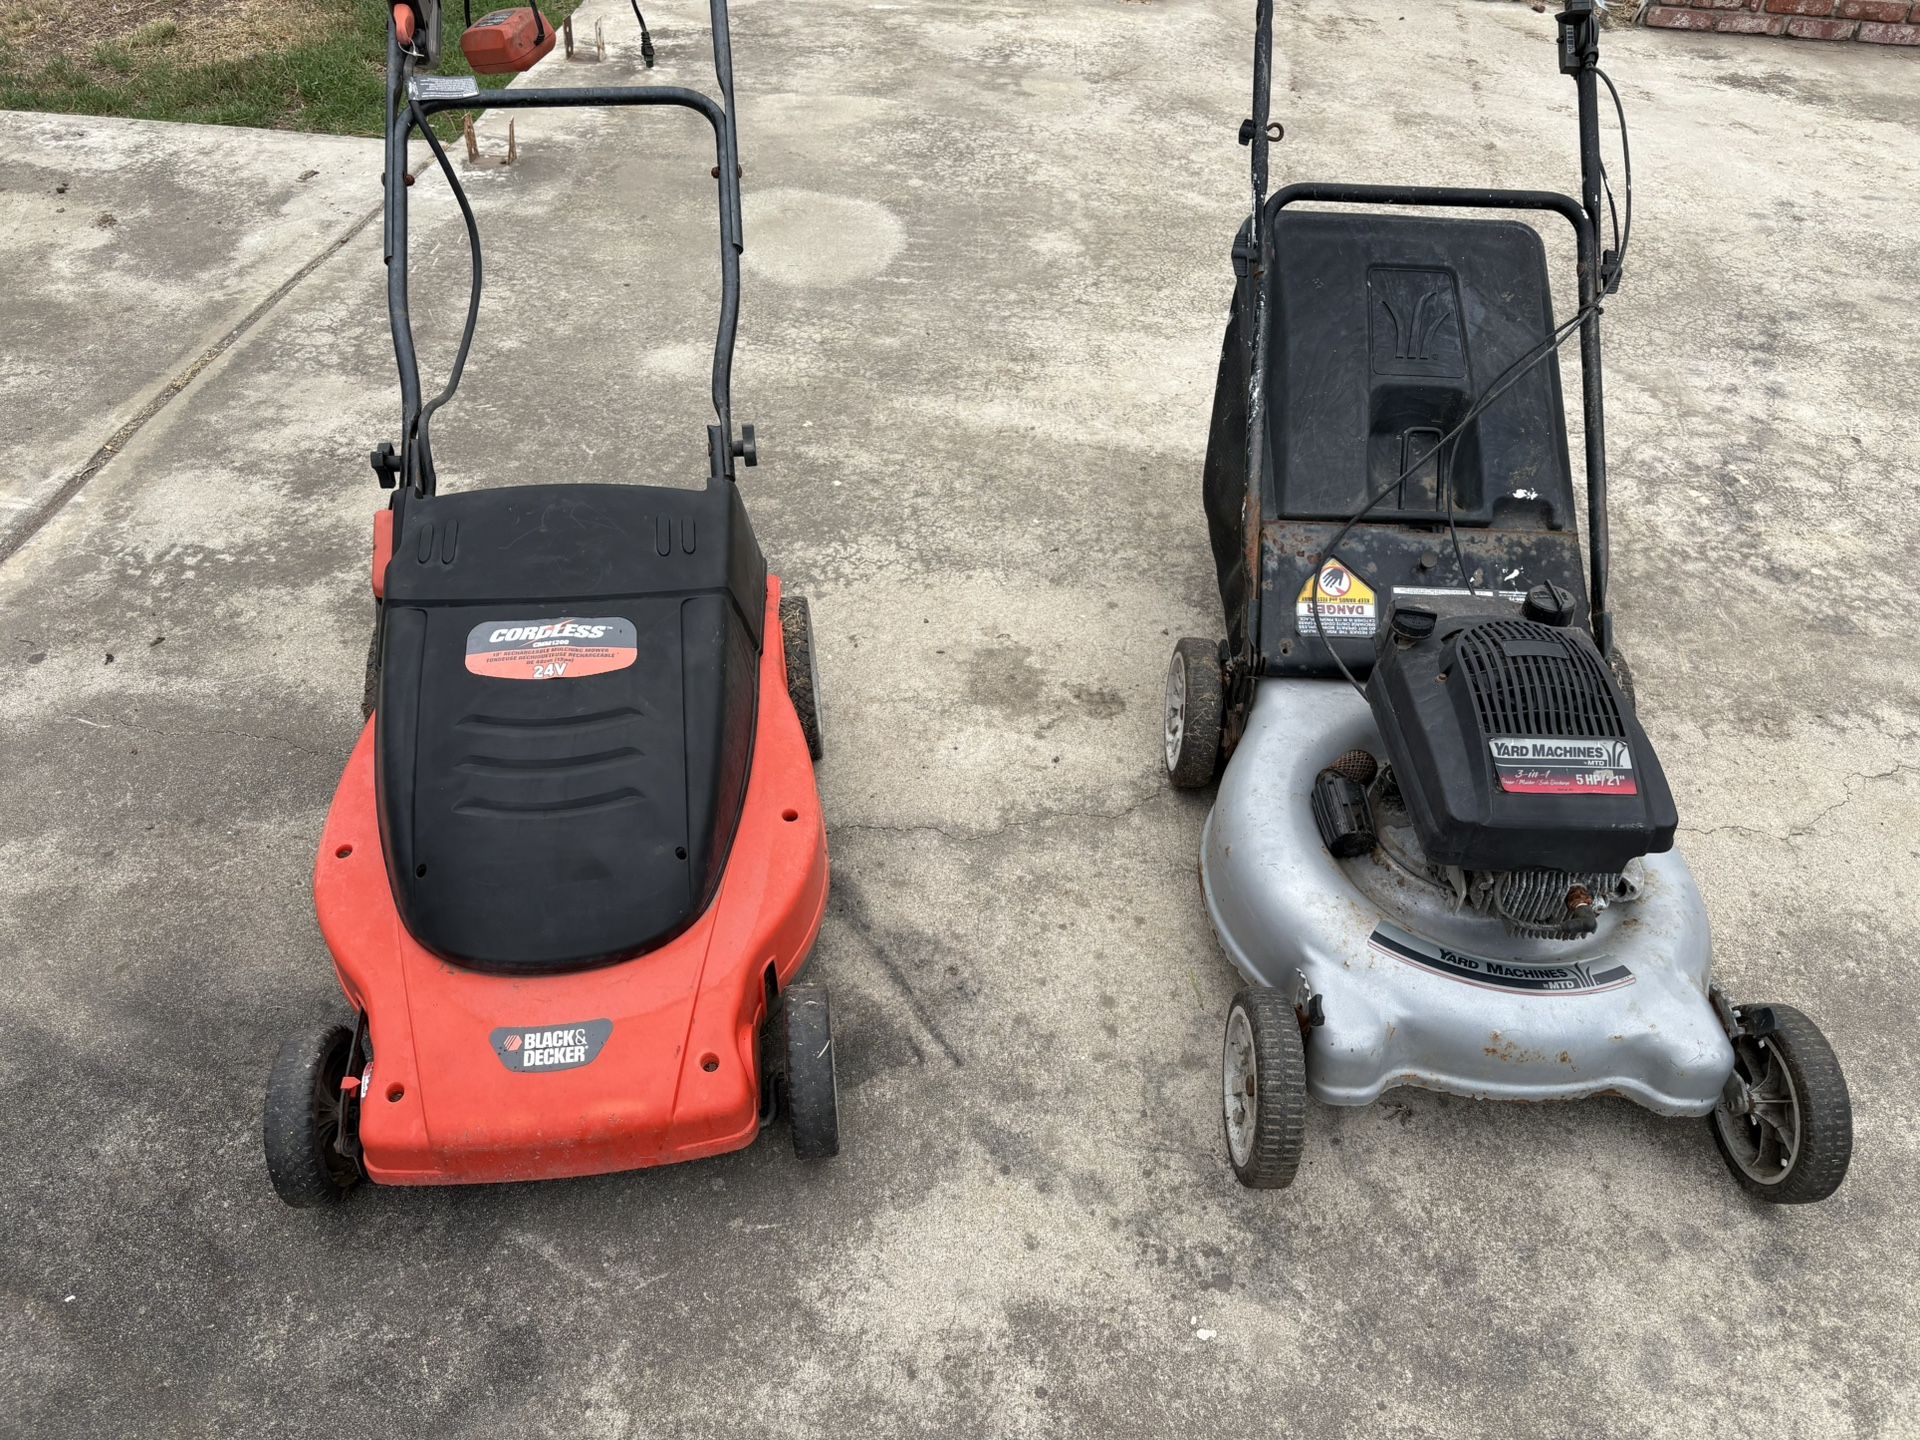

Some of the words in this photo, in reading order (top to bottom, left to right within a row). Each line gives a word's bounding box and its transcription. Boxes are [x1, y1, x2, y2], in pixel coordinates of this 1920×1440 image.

[1307, 604, 1364, 615] DANGER
[489, 623, 606, 643] CORDLESS
[504, 648, 550, 657] RECHARGEABLE
[533, 663, 568, 678] 24V
[1494, 742, 1529, 757] YARD
[1532, 744, 1604, 759] MACHINES
[1576, 774, 1584, 785] 5
[1439, 948, 1479, 969] YARD
[1487, 962, 1569, 978] MACHINES
[1549, 980, 1575, 990] MTD
[523, 1046, 585, 1067] DECKER
